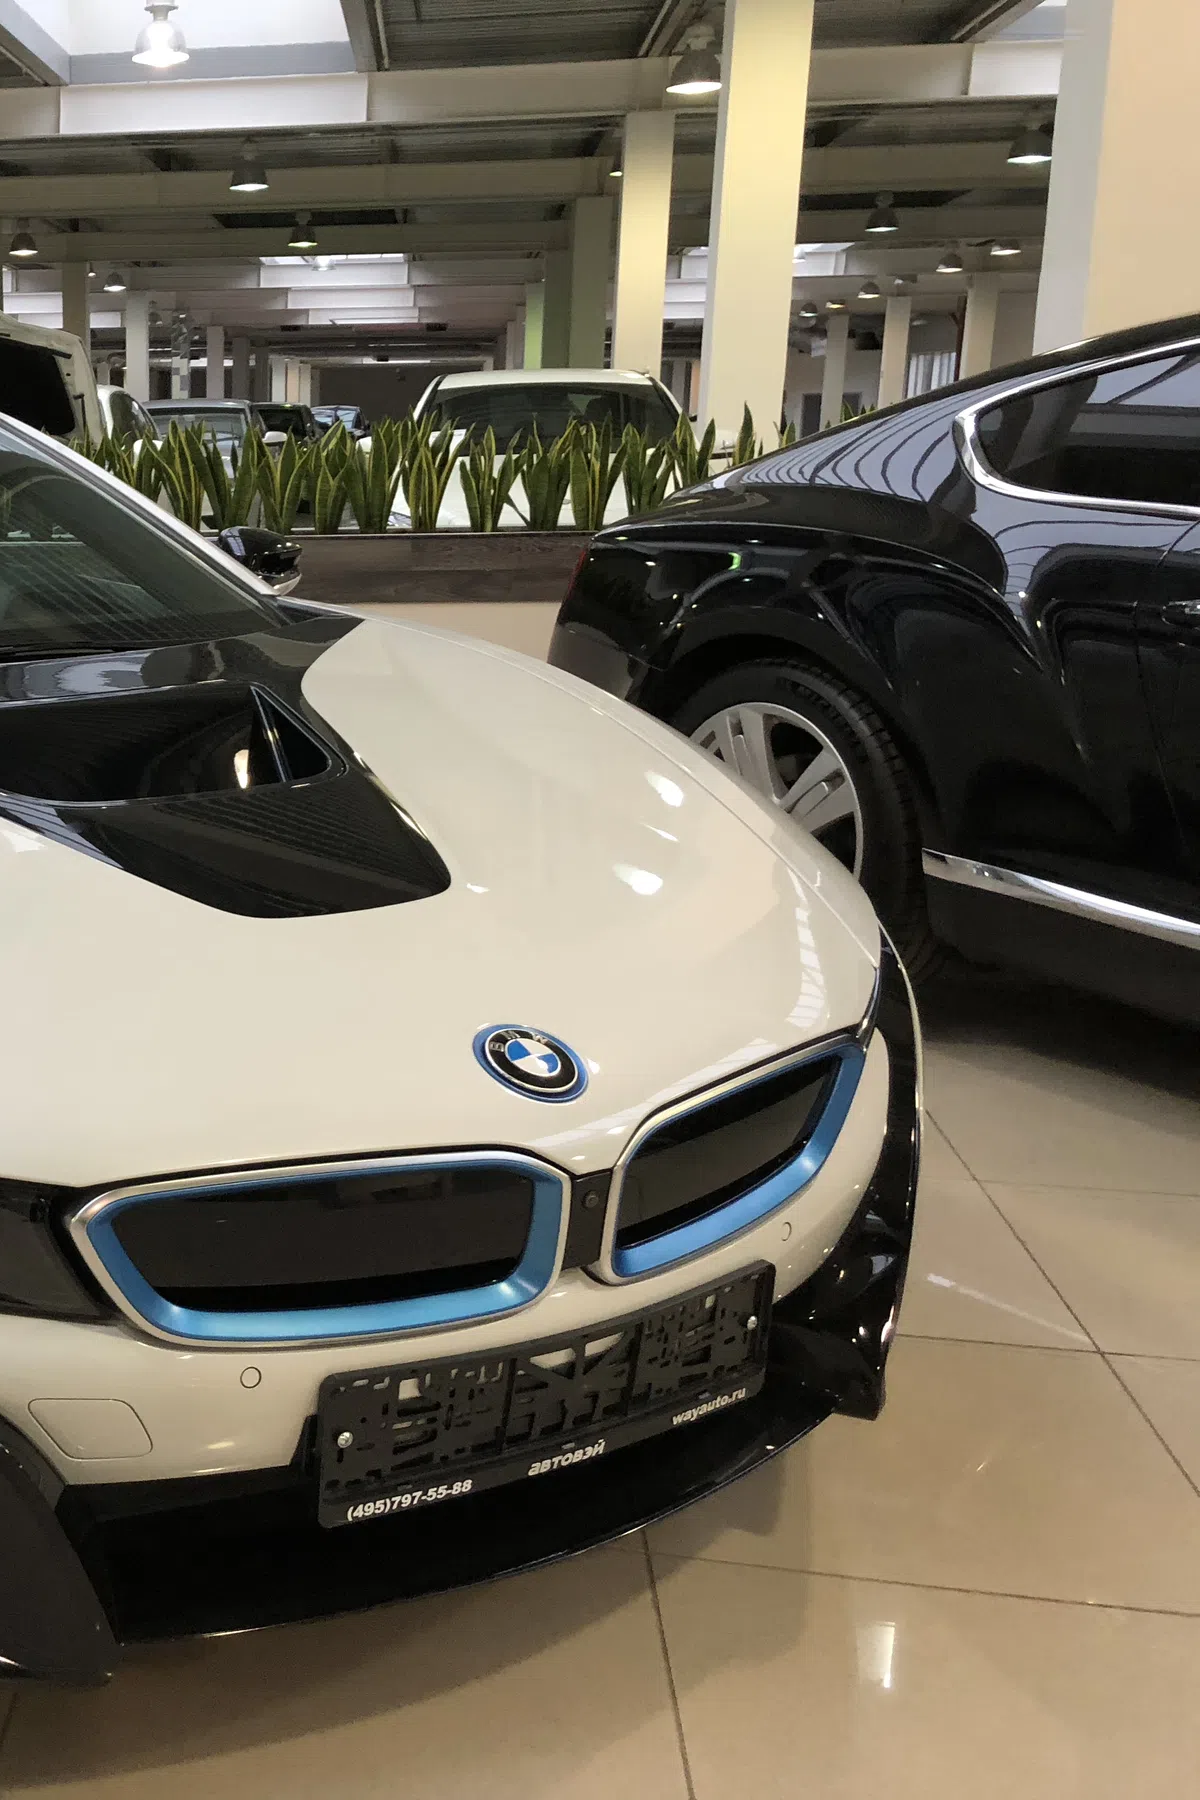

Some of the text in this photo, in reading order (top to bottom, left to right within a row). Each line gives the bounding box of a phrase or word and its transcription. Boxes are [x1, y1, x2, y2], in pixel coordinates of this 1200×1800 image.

[489, 1030, 549, 1053] BMW
[672, 1387, 746, 1426] wayauto.ru
[346, 1478, 473, 1522] (495)797-55-88
